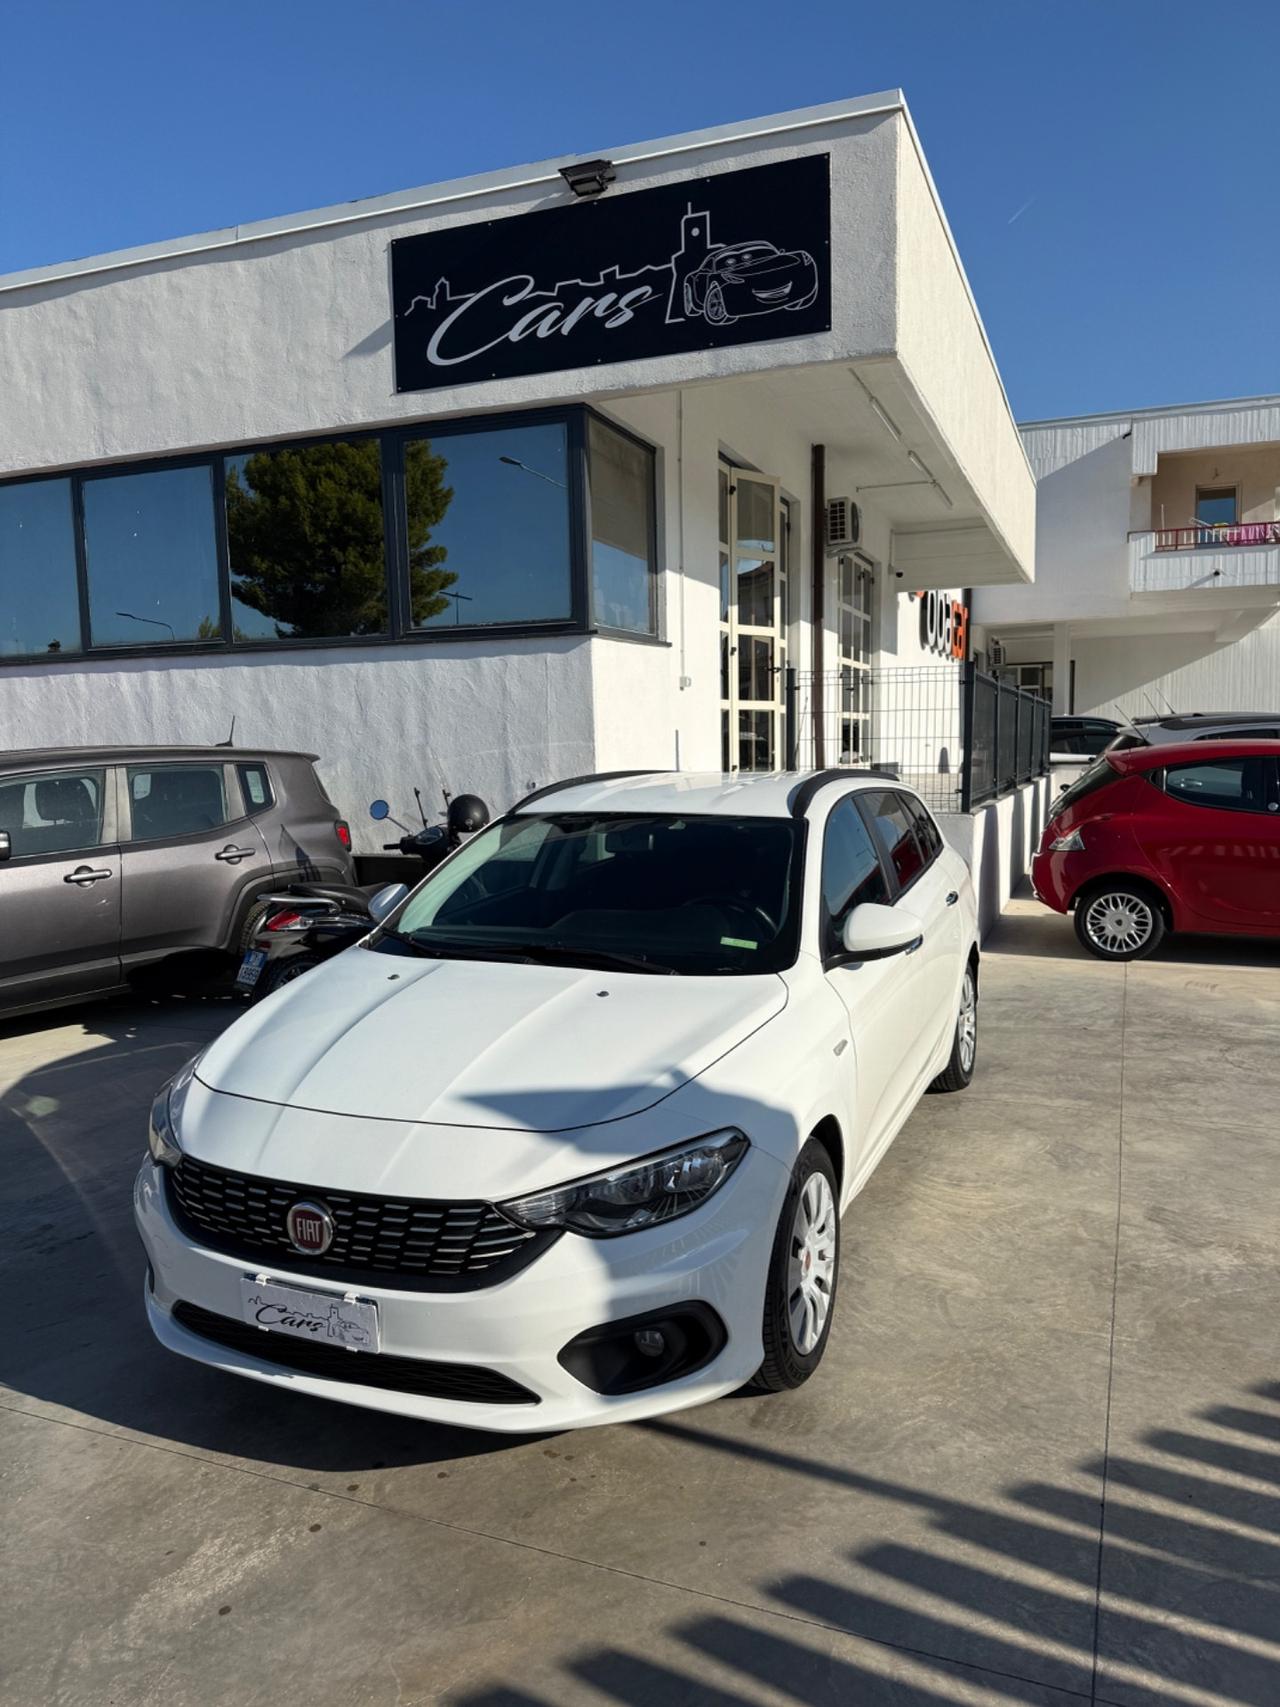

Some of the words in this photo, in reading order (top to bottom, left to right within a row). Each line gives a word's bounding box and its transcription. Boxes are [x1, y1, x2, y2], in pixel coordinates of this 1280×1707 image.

[426, 275, 661, 366] Cars
[296, 1217, 321, 1243] FIAT
[255, 1304, 326, 1332] Cars
